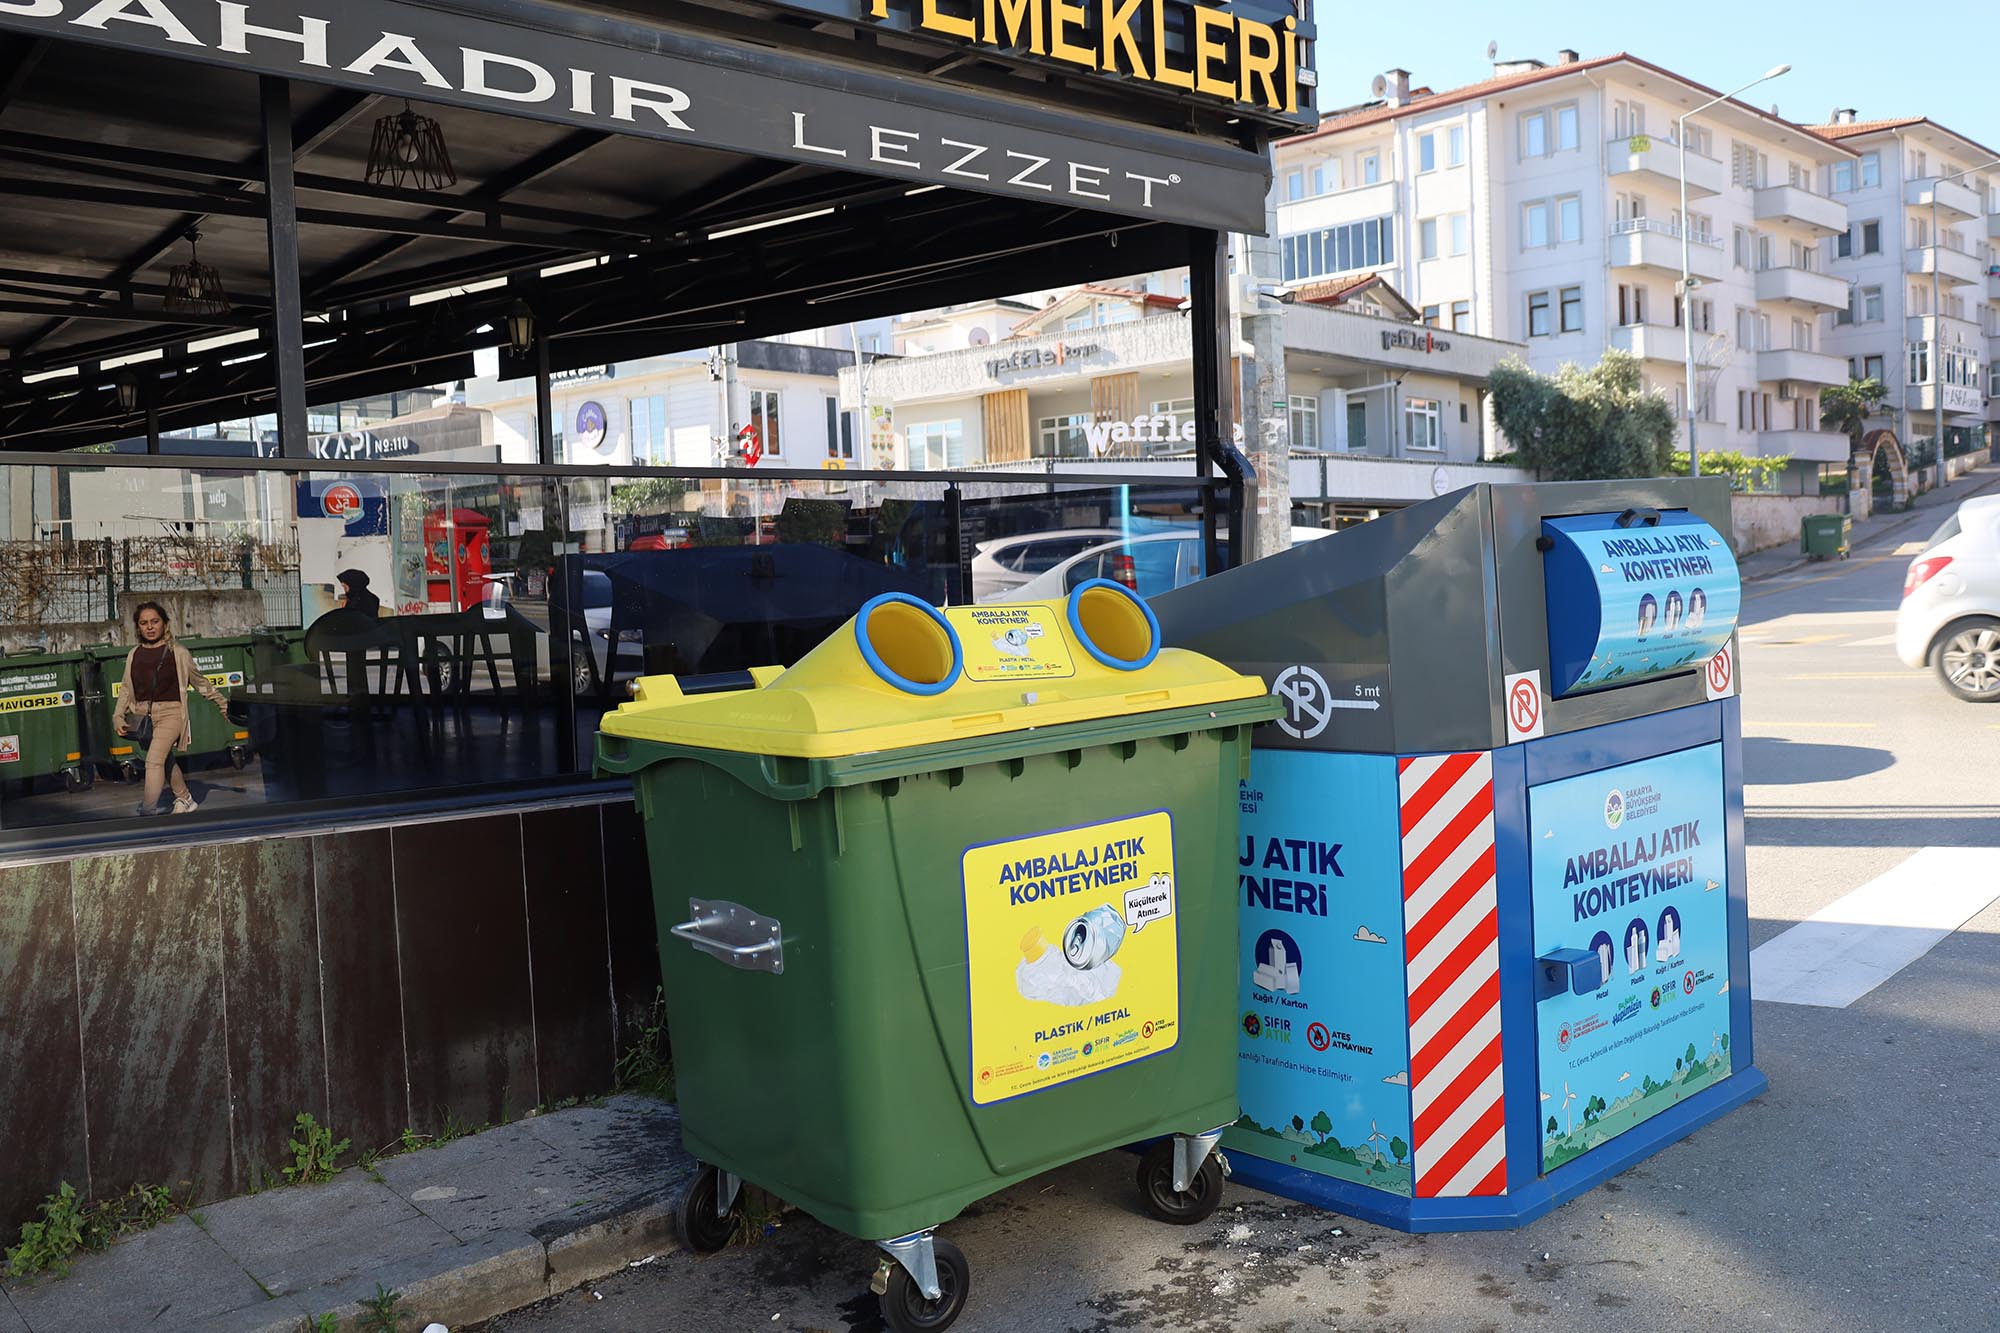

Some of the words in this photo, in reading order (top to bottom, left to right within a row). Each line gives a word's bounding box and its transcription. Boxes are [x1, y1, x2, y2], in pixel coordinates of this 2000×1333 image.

[870, 0, 1297, 114] MEKLERİ
[1602, 536, 1676, 558] AMBALAJ
[1674, 534, 1710, 553] ATIK
[971, 610, 1010, 618] AMBALAJ
[1355, 685, 1362, 697] 5
[1364, 685, 1380, 697] mt
[1240, 789, 1264, 802] EHİR
[1625, 785, 1652, 799] SAKARYA
[1626, 804, 1658, 821] BELEDİYESİ
[999, 846, 1098, 885] AMBALAJ
[1103, 836, 1146, 864] ATIK
[1262, 837, 1345, 877] ATIK
[1563, 832, 1657, 889] AMBALAJ
[1660, 819, 1701, 857] ATIK
[1128, 892, 1168, 909] Küçülterek
[1252, 992, 1274, 1004] Kağıt
[1281, 997, 1308, 1010] Karton
[1095, 1008, 1130, 1026] METAL
[1264, 1016, 1291, 1031] SIFIR
[1265, 1028, 1292, 1043] ATIK
[1332, 1031, 1351, 1042] ATEŞ
[1332, 1041, 1373, 1055] ATMAYINIZ
[1261, 1055, 1298, 1071] Tarafından
[1299, 1064, 1316, 1075] Hibe
